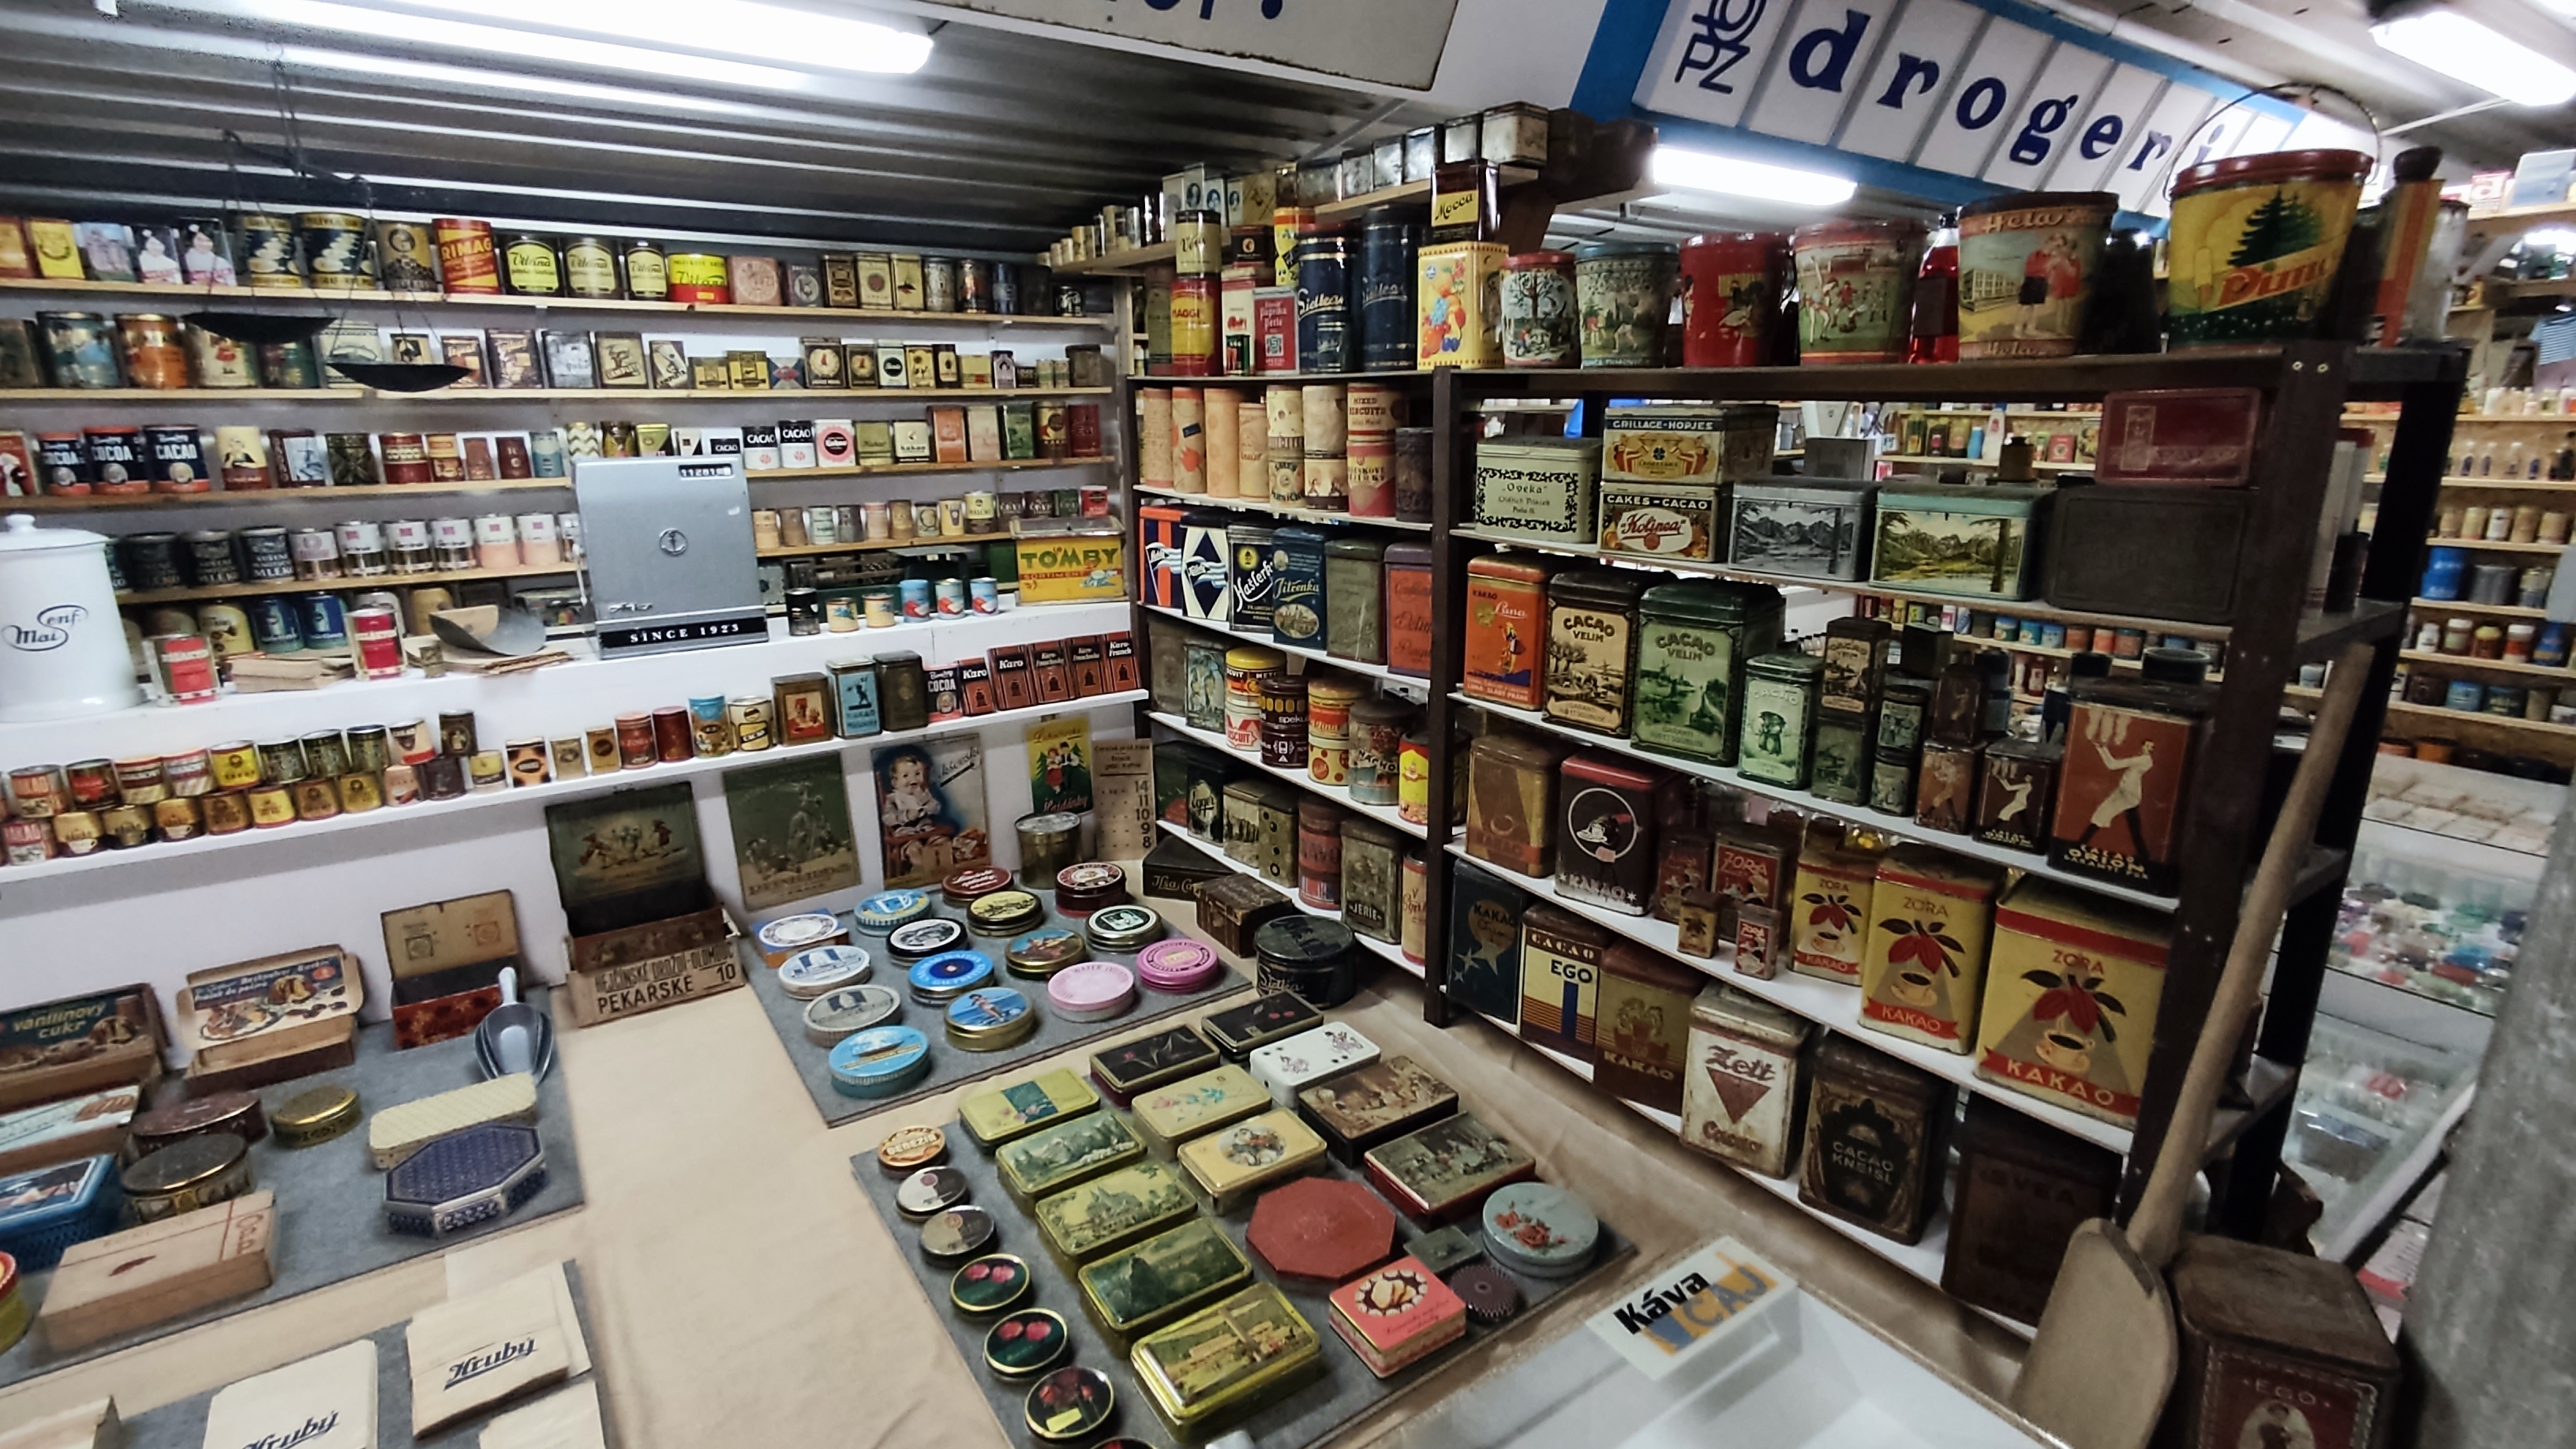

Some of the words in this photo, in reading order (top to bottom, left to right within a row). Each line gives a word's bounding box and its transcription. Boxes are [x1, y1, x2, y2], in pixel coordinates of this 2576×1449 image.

[1435, 193, 1473, 221] Mocca
[510, 251, 552, 268] Vitana
[1172, 308, 1200, 319] MAGGI
[782, 428, 811, 440] CACAO
[1612, 419, 1713, 431] GRILLAGE-HOPJES
[747, 433, 776, 444] CACAO
[155, 444, 197, 460] CACAO
[1608, 494, 1650, 506] CAKES
[1662, 497, 1708, 510] CACAO
[1020, 547, 1119, 569] TOMBY
[1024, 571, 1085, 580] SORTIMENT
[1234, 560, 1273, 612] Hašlerk
[630, 627, 688, 644] SINCE
[1563, 615, 1616, 638] CACAO
[1573, 629, 1604, 643] VELIM
[1654, 632, 1716, 657] CACAO
[1666, 647, 1704, 662] VELIM
[962, 668, 987, 680] Karo
[999, 659, 1024, 670] Karo
[928, 679, 957, 693] COCOA
[1753, 687, 1799, 706] CACAO
[1358, 748, 1399, 772] NACHO
[1135, 780, 1148, 792] 14
[1139, 795, 1149, 807] 11
[1135, 808, 1151, 821] 10
[1140, 822, 1150, 834] 9
[1142, 836, 1151, 848] 8
[1720, 850, 1768, 876] ZORA
[2068, 848, 2145, 873] ORION
[2080, 844, 2135, 863] CACAO
[1569, 874, 1627, 903] KAKAO
[1818, 877, 1849, 893] ZORA
[1473, 904, 1518, 927] KAKAO
[1903, 896, 1950, 919] ZORA
[1740, 923, 1765, 938] ZORA
[1530, 932, 1595, 960] CACAO
[1550, 960, 1593, 983] EGO
[1805, 953, 1848, 973] KAKAO
[2053, 949, 2105, 976] ZORA
[716, 963, 736, 982] 10
[1881, 1005, 1941, 1034] KAKAO
[38, 1020, 88, 1040] cukr
[1603, 1051, 1675, 1080] KAKAO
[1705, 1043, 1777, 1084] Zett
[2007, 1058, 2116, 1106] KAKAO
[1832, 1141, 1894, 1173] CACAO
[1831, 1152, 1893, 1185] KNEISL
[1612, 1271, 1711, 1335] Káva
